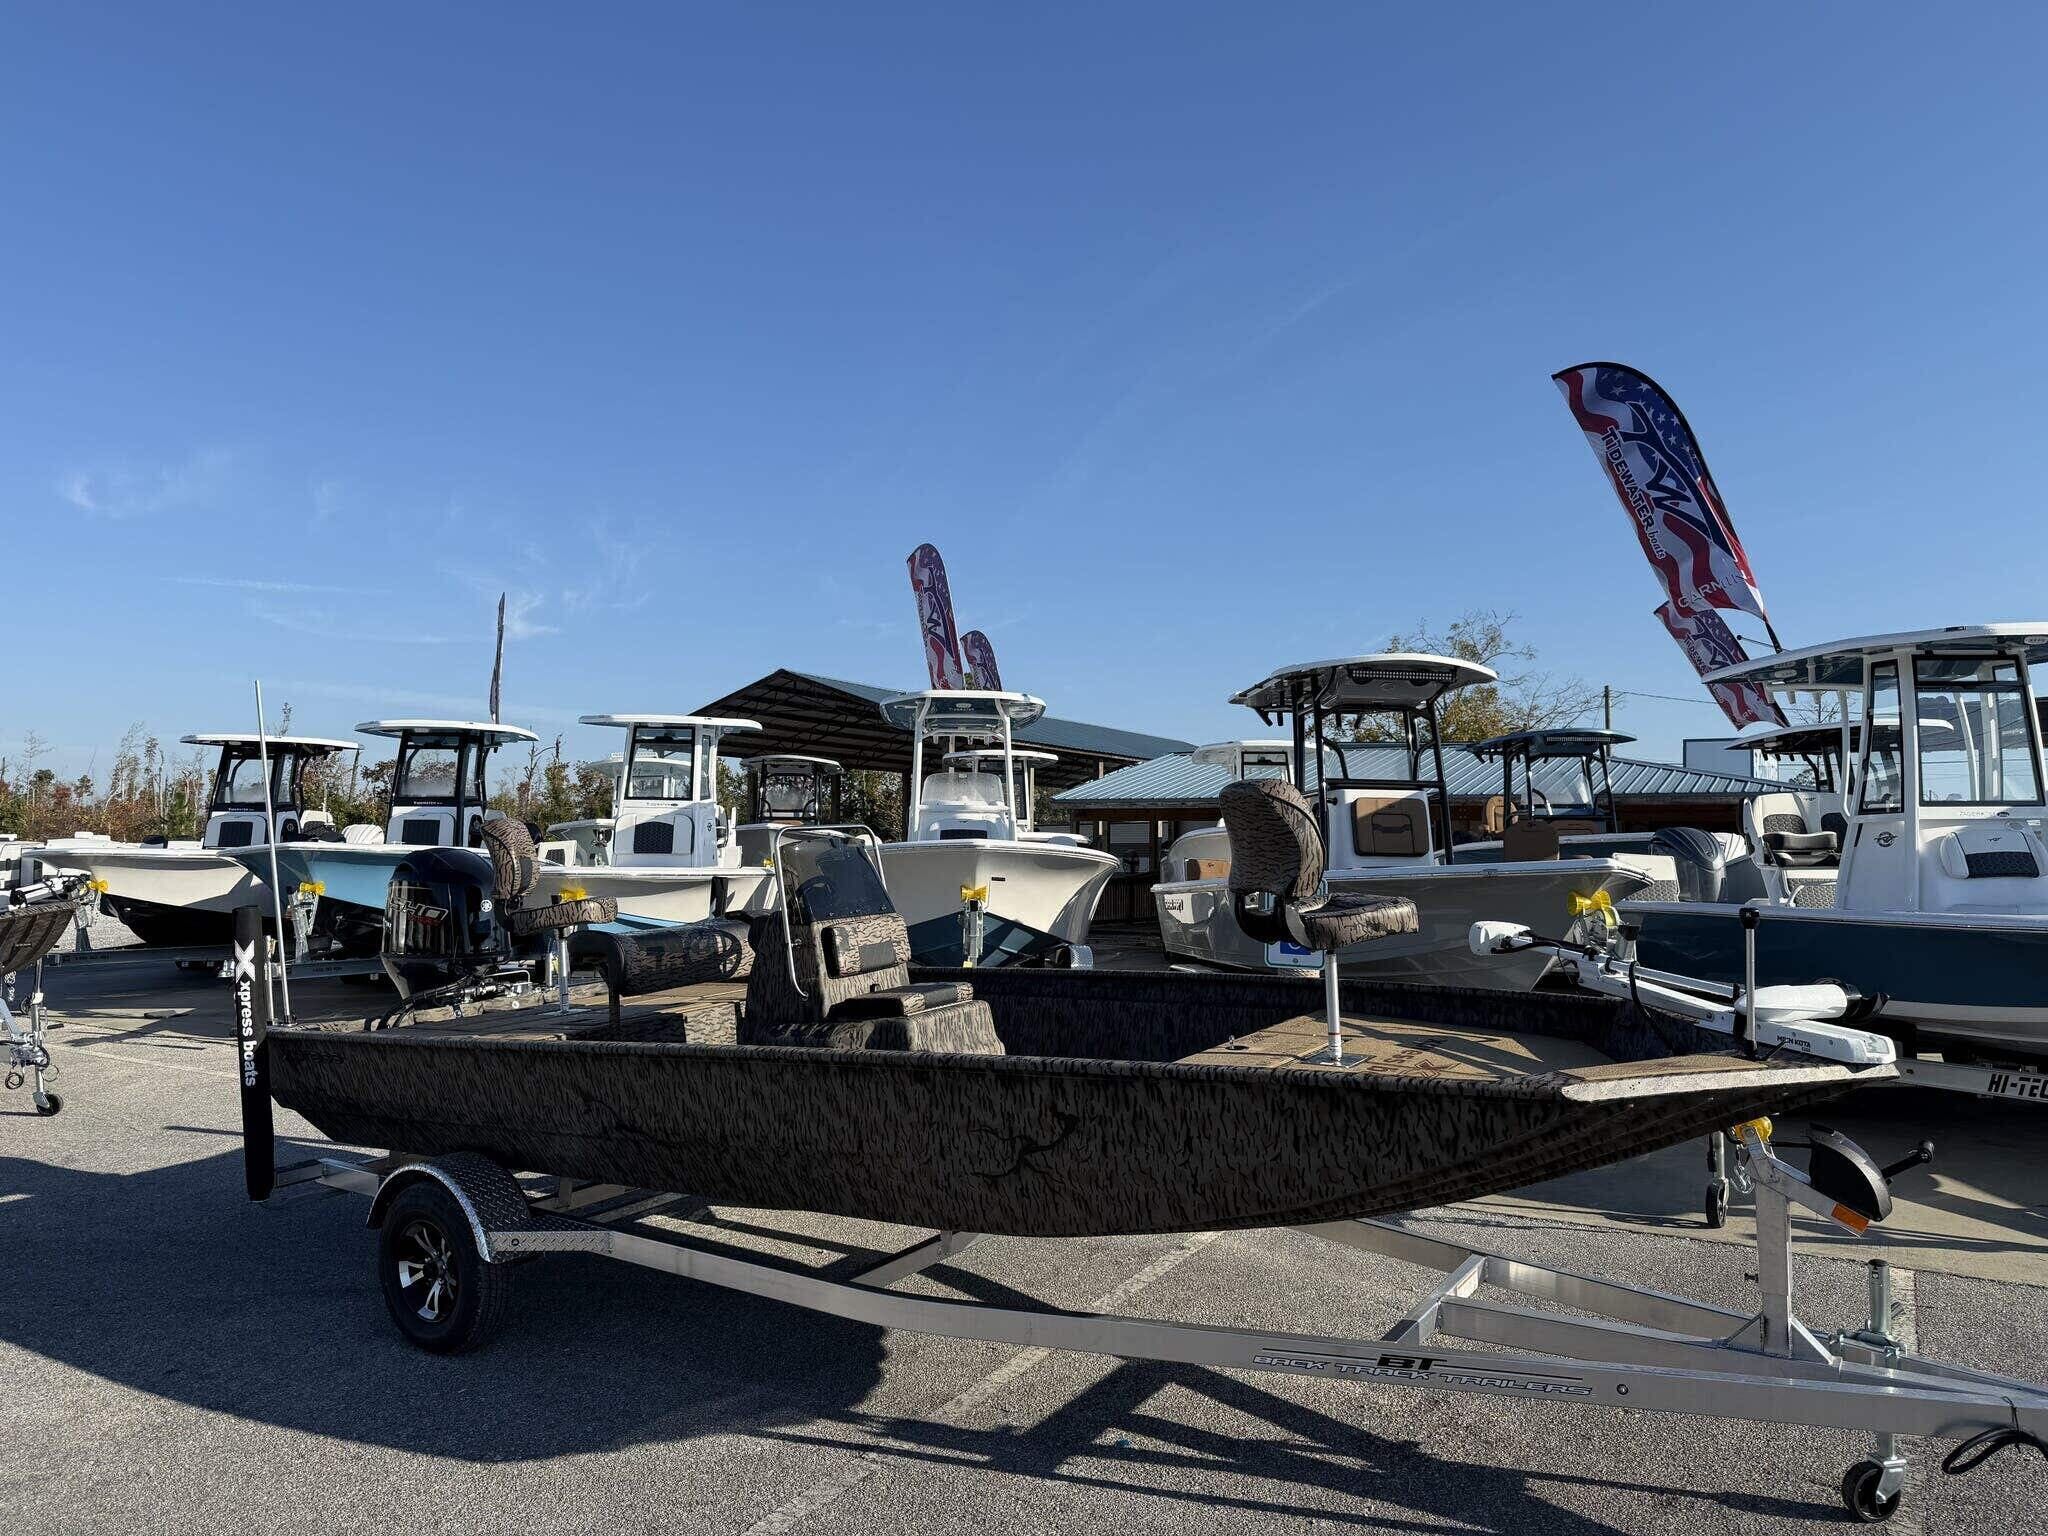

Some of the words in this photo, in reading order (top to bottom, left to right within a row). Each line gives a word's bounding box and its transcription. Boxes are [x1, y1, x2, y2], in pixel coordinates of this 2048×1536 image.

[1601, 426, 1655, 531] TIDEWATER
[1646, 530, 1666, 560] boats
[1683, 633, 1713, 674] TIDEWA
[237, 980, 255, 1037] xpress
[243, 1040, 258, 1087] boats
[1253, 1355, 1329, 1371] BACK
[1335, 1362, 1437, 1381] TRACK
[1440, 1373, 1596, 1396] TRAILERS
[1377, 1354, 1449, 1373] BT
